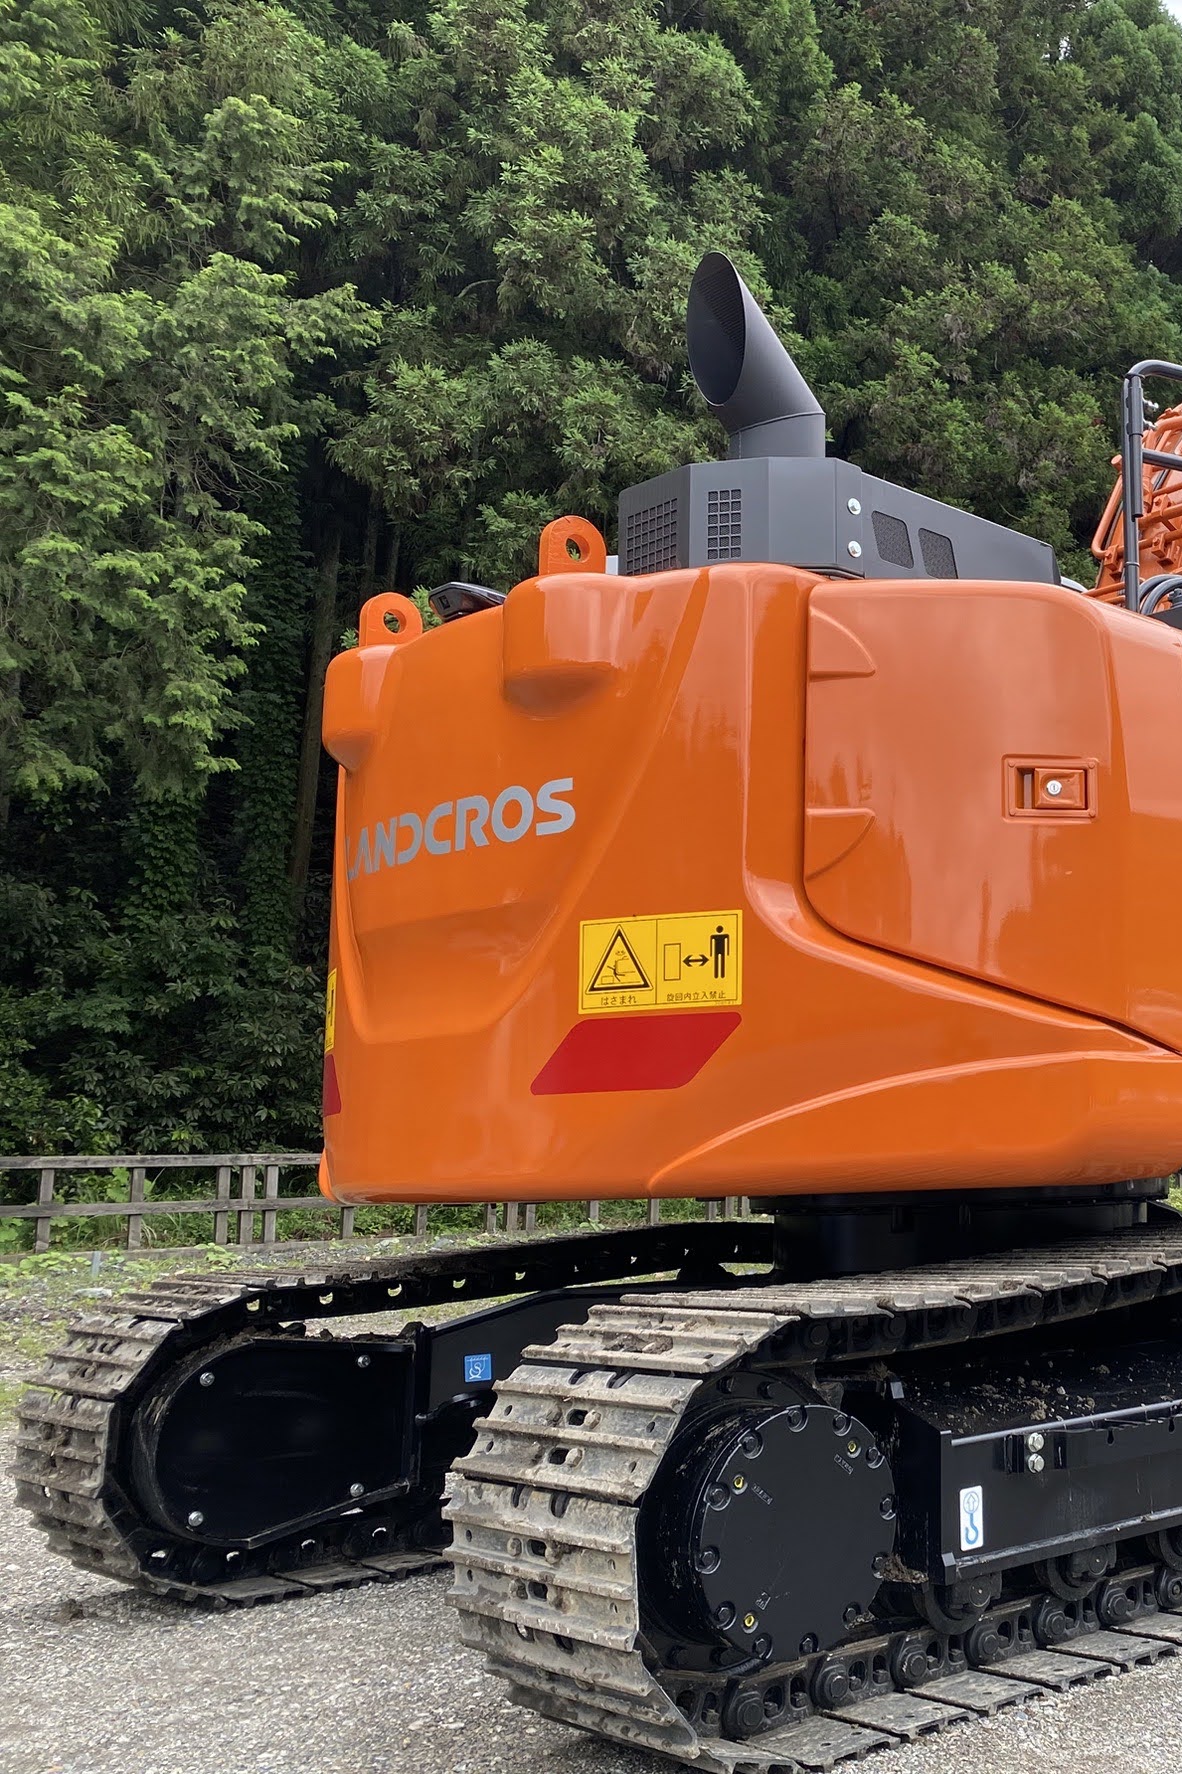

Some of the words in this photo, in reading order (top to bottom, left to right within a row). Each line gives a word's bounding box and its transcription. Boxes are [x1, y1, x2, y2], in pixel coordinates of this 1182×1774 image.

[600, 995, 637, 1006] はさまれ
[666, 990, 727, 1002] 旋回内立入禁止
